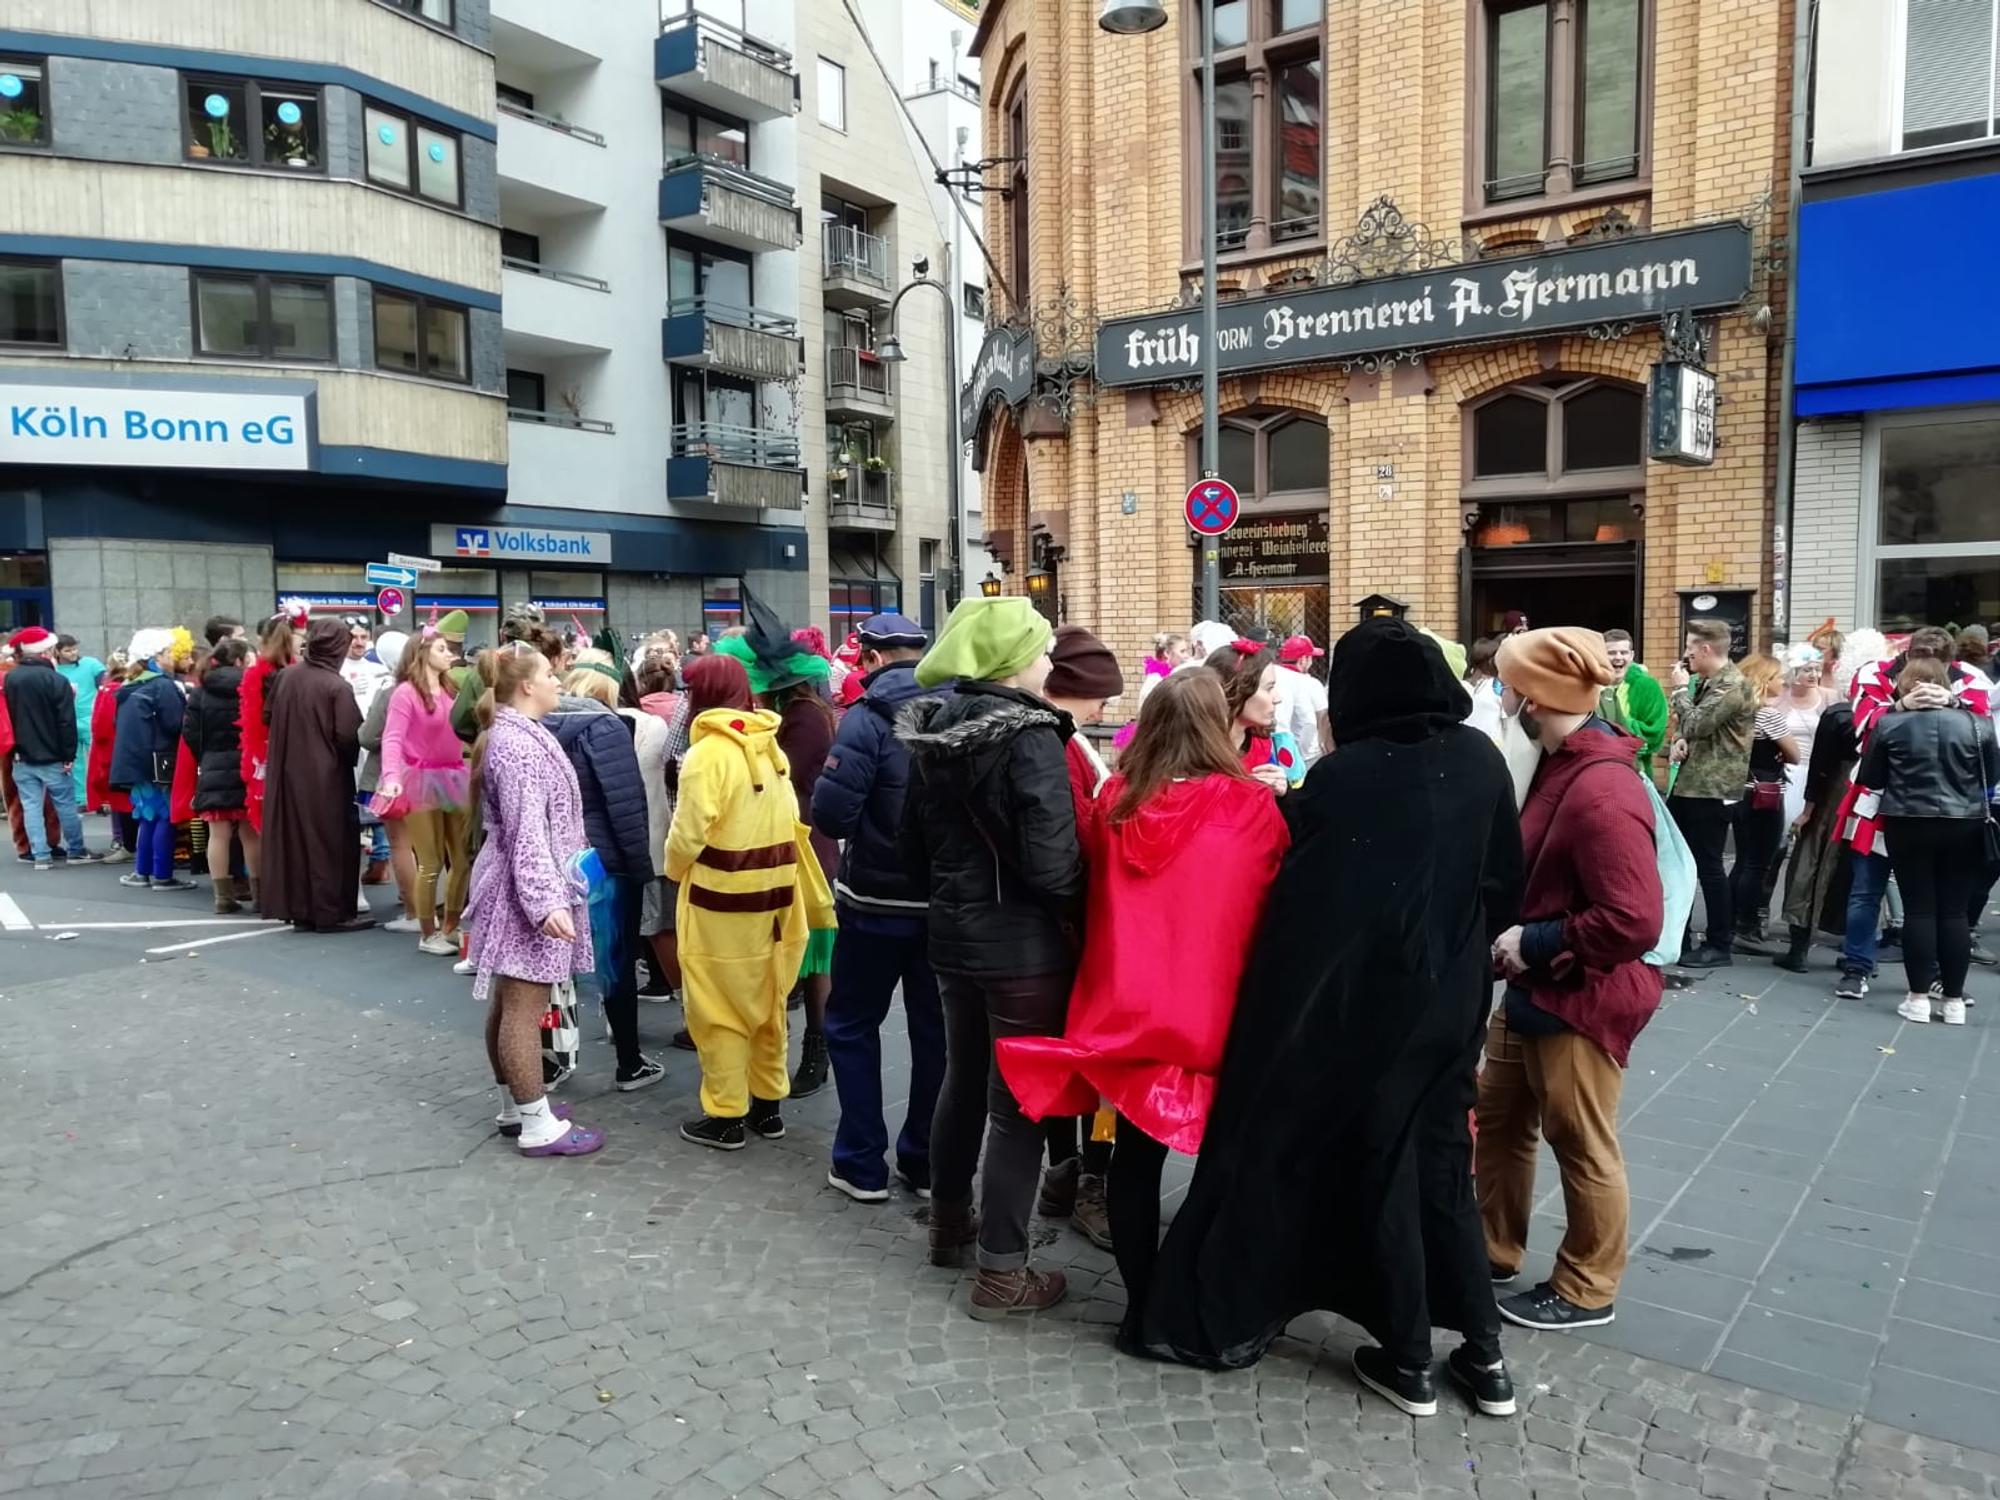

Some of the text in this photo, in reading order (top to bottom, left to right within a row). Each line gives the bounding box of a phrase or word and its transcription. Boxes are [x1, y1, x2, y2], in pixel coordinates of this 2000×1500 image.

[1124, 257, 1699, 369] früh ORM Brennerei A. Hermann
[11, 406, 294, 444] Köln Bonn eG
[495, 531, 591, 554] Volksbank
